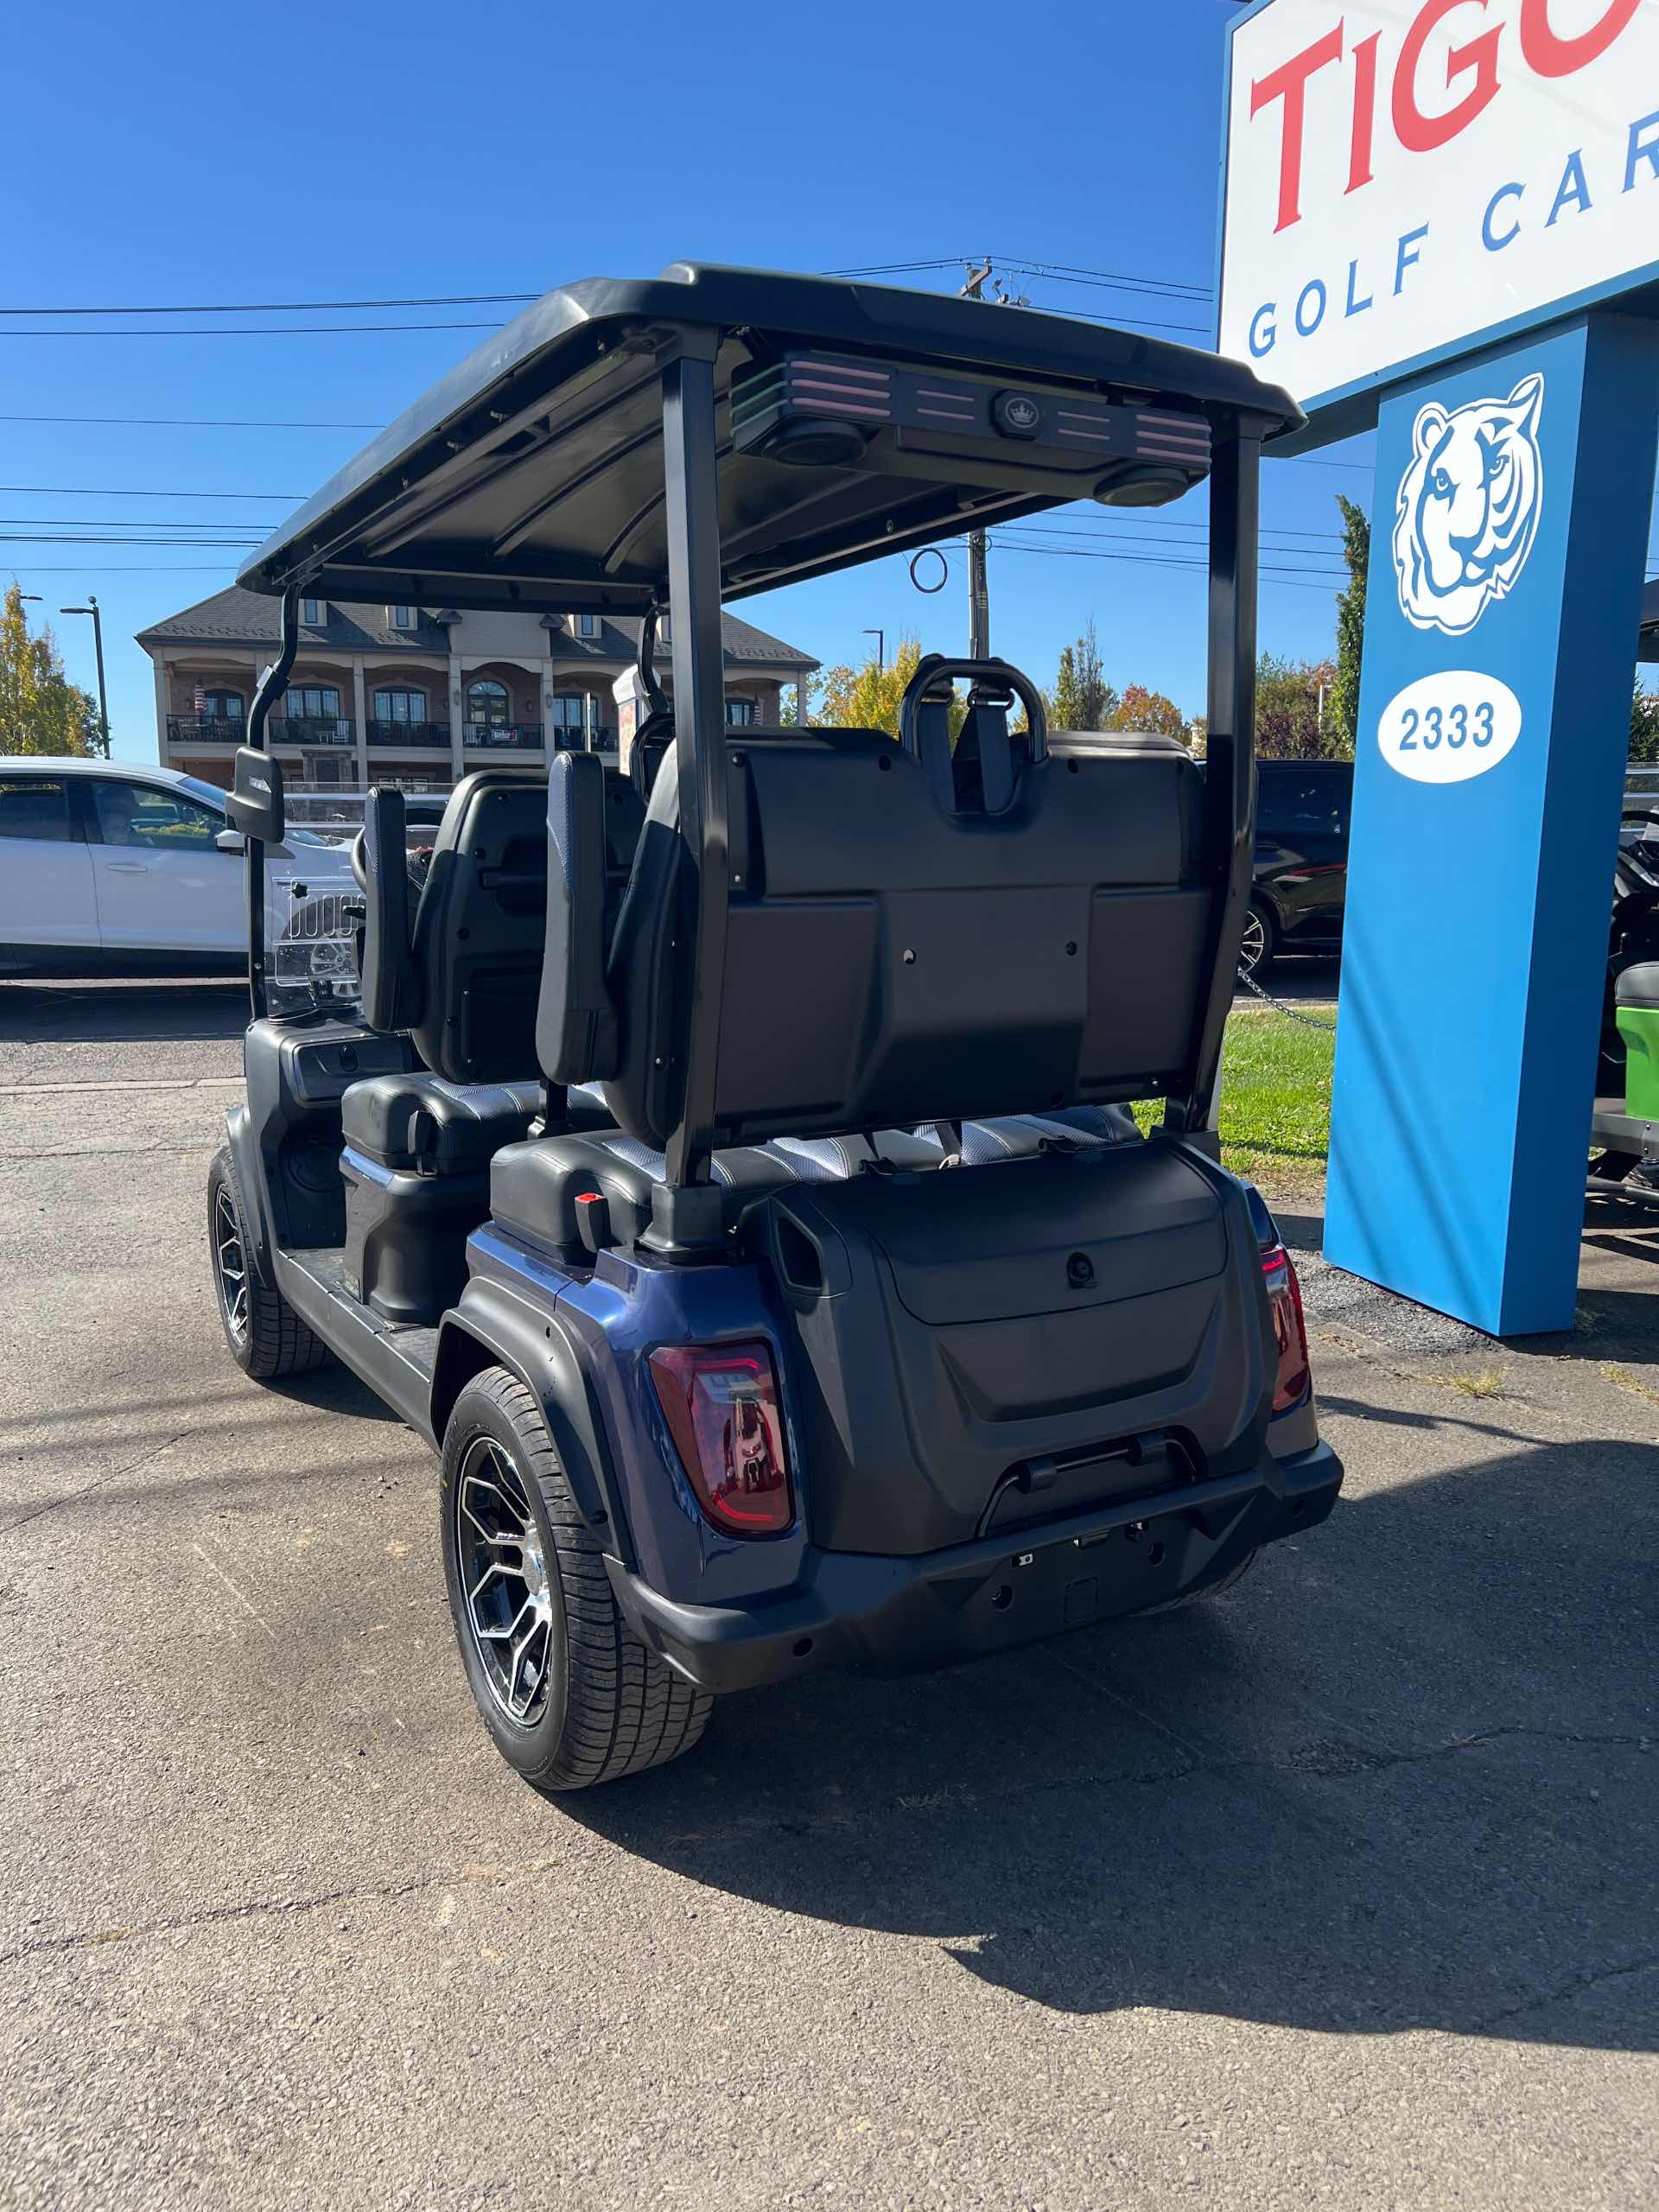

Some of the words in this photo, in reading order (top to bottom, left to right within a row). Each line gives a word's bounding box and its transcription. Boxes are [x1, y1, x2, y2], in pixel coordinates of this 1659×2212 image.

[1249, 221, 1429, 358] GOLF
[1482, 111, 1659, 251] CAR
[1399, 702, 1494, 751] 2333
